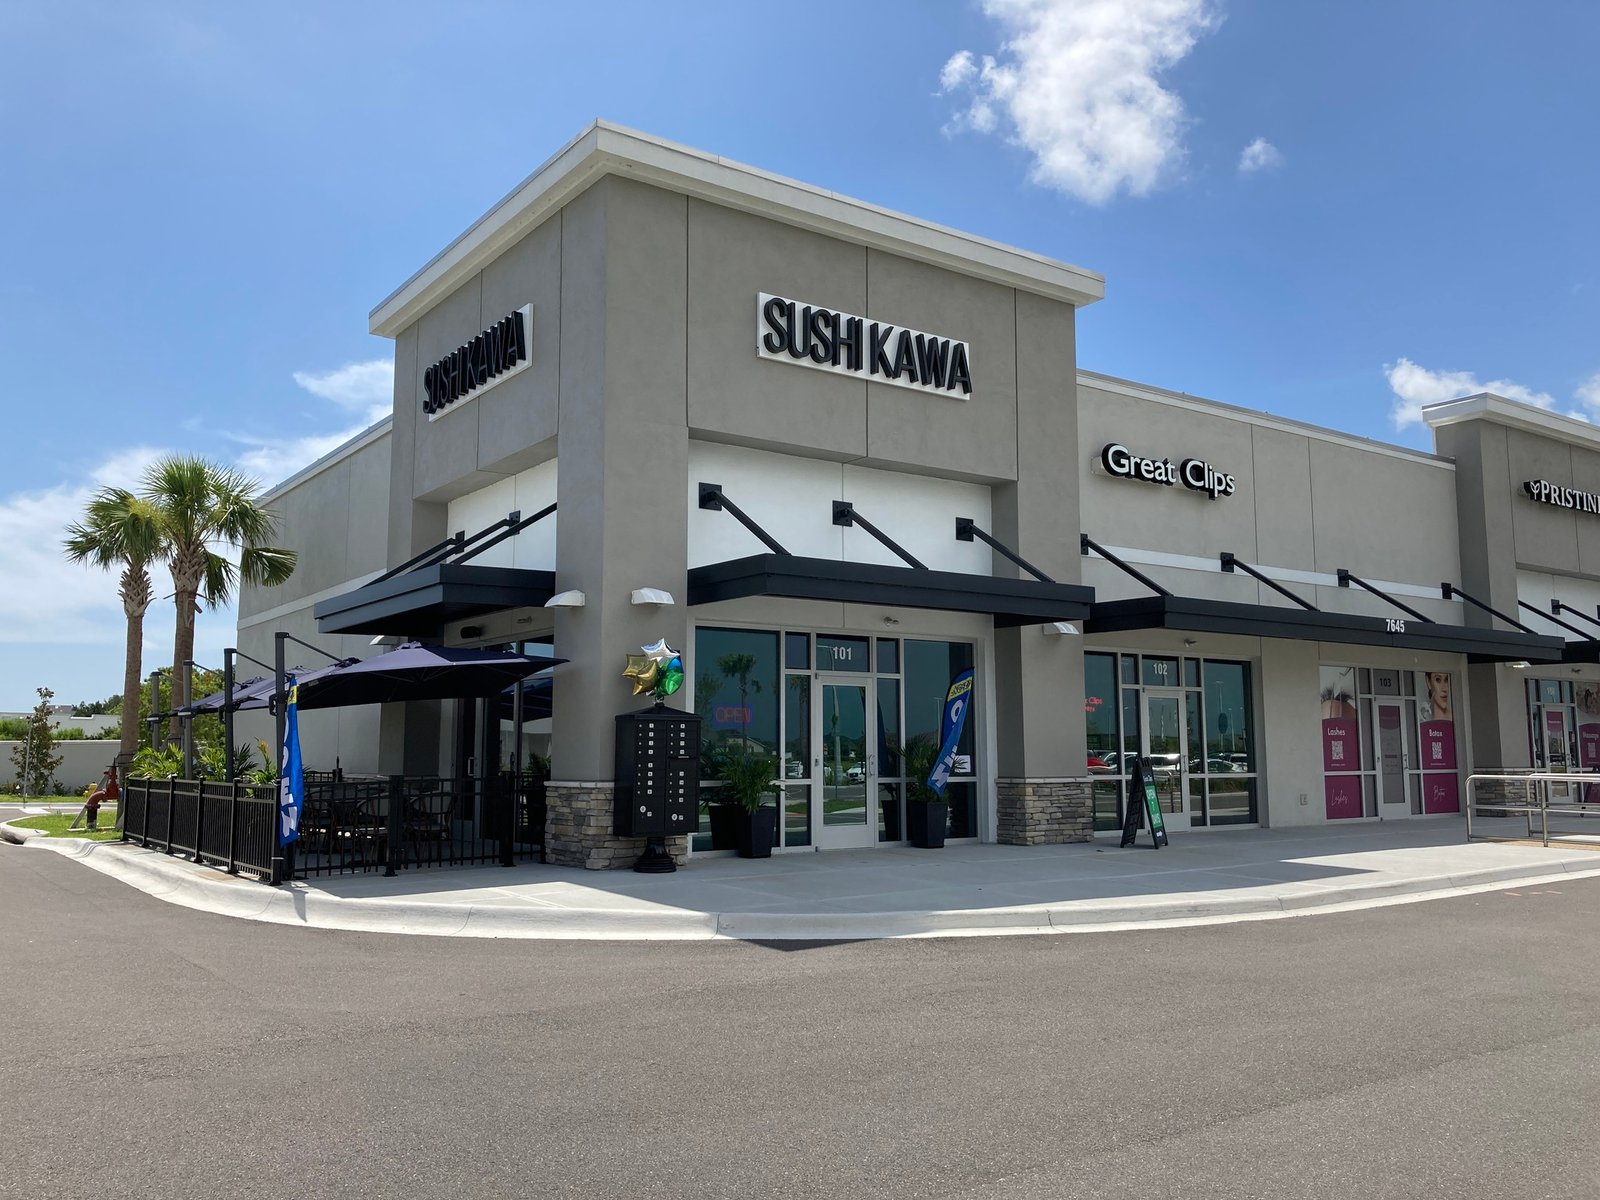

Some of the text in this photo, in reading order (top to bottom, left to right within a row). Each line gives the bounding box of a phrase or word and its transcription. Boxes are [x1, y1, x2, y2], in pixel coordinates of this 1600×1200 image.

[763, 297, 972, 394] SUSHI KAWA
[423, 311, 526, 414] SUSHI KAWA
[1102, 443, 1236, 500] Great Clips
[1385, 618, 1405, 633] 7645
[832, 646, 852, 661] 101
[1153, 663, 1168, 675] 102
[1379, 678, 1392, 688] 103
[715, 706, 752, 723] OPEN
[1327, 726, 1346, 736] Lashes
